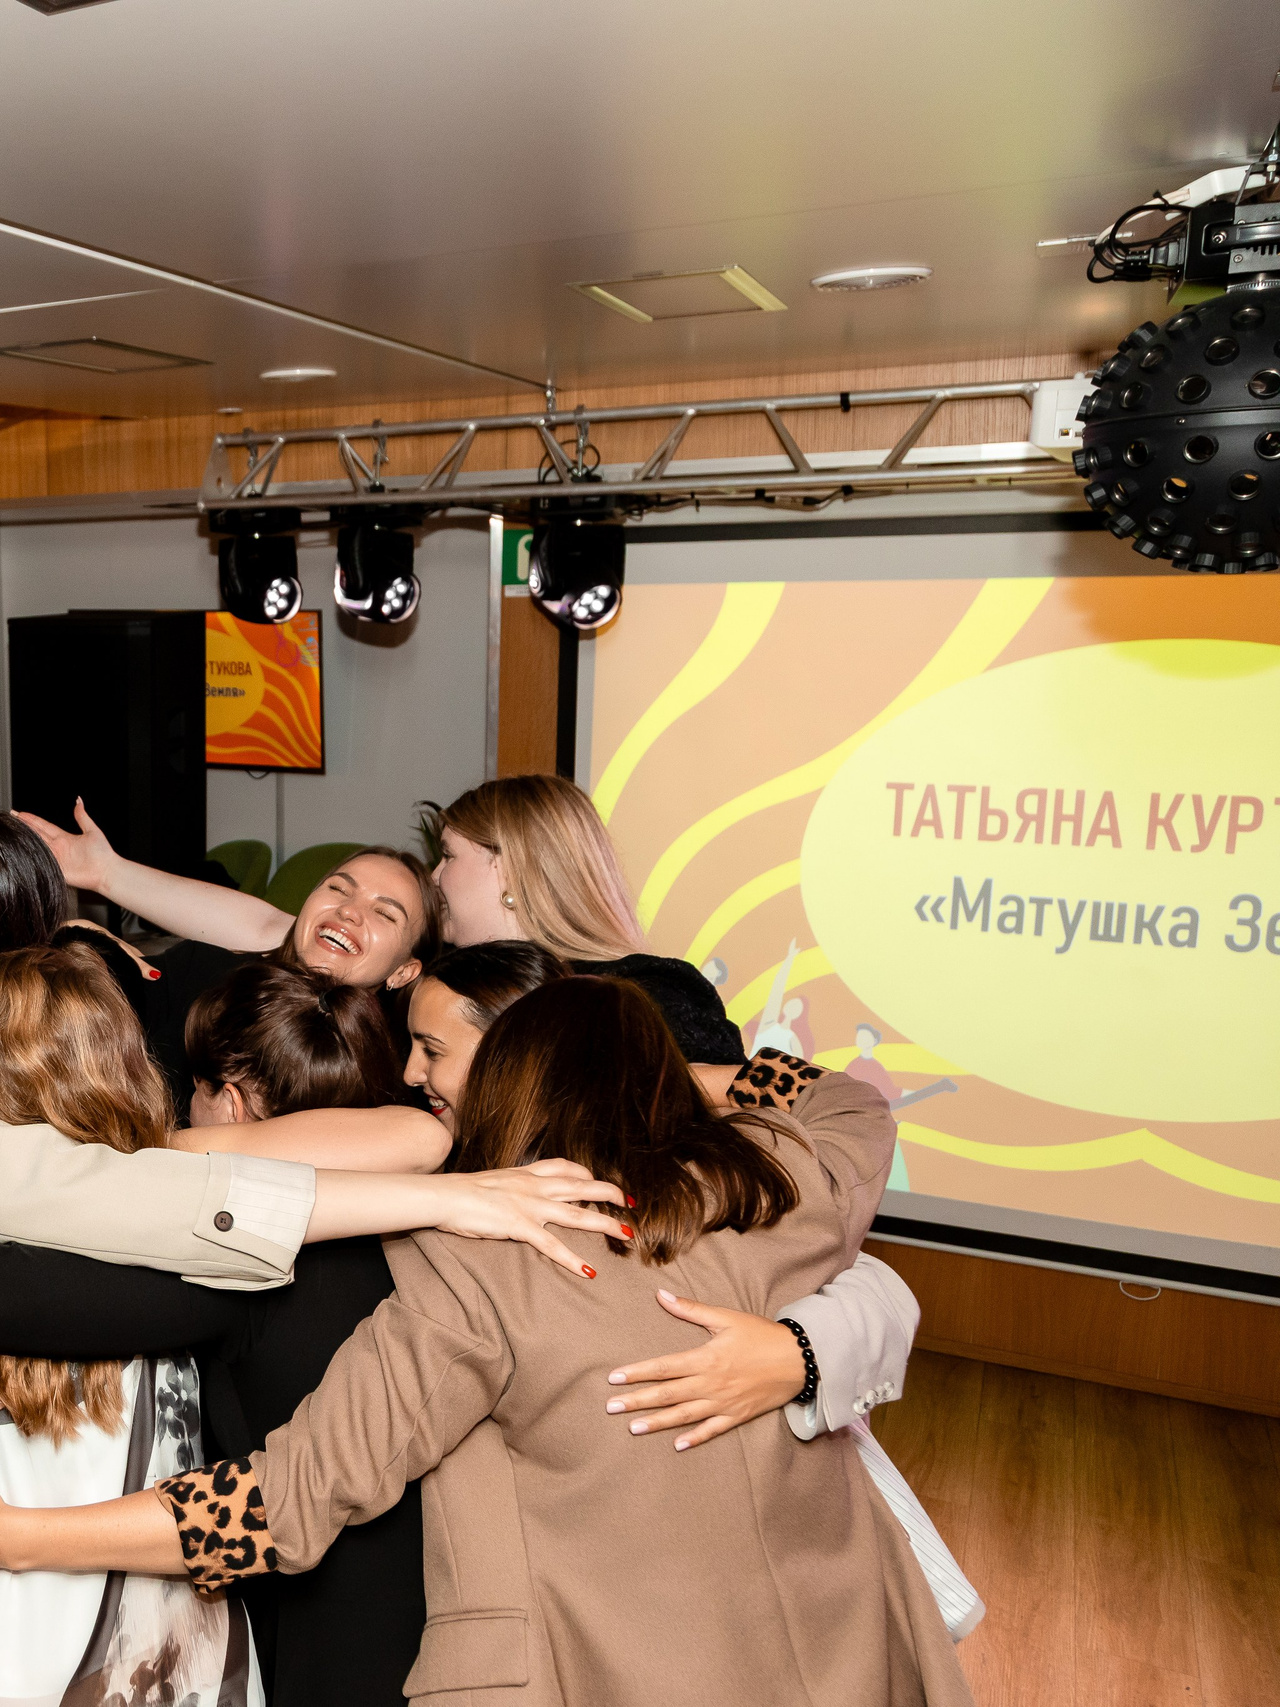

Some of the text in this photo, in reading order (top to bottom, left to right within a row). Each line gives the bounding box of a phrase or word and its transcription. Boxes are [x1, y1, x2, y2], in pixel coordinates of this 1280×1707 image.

[886, 782, 1280, 855] ТАТЬЯНА КУР
[913, 876, 1200, 955] «Матушка
